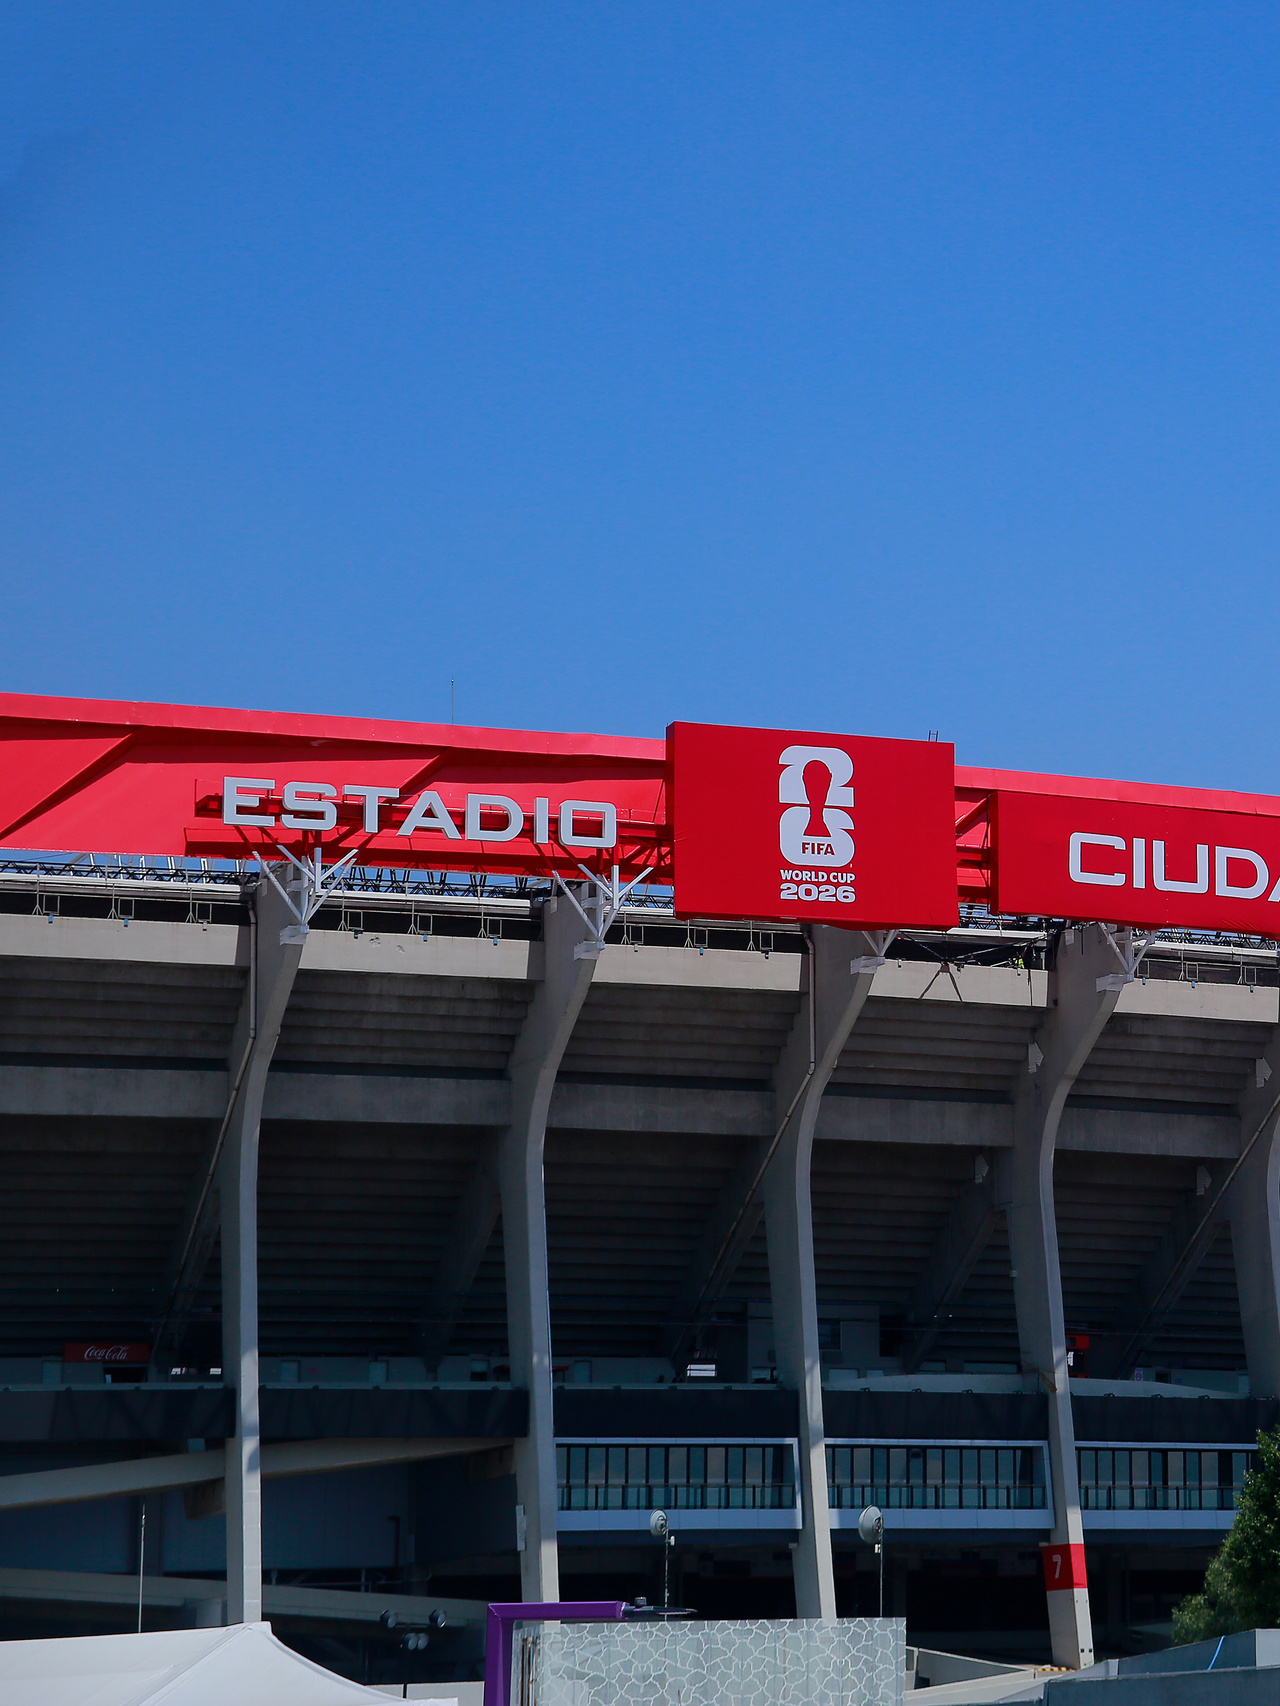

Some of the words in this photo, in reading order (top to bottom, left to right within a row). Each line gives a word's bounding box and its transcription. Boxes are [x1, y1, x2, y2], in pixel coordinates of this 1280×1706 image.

[222, 776, 618, 849] ESTADIO
[801, 842, 835, 856] FIFA
[779, 869, 828, 882] WORLD
[829, 871, 856, 884] CUP
[779, 882, 856, 903] 2026
[1051, 1554, 1062, 1579] 7
